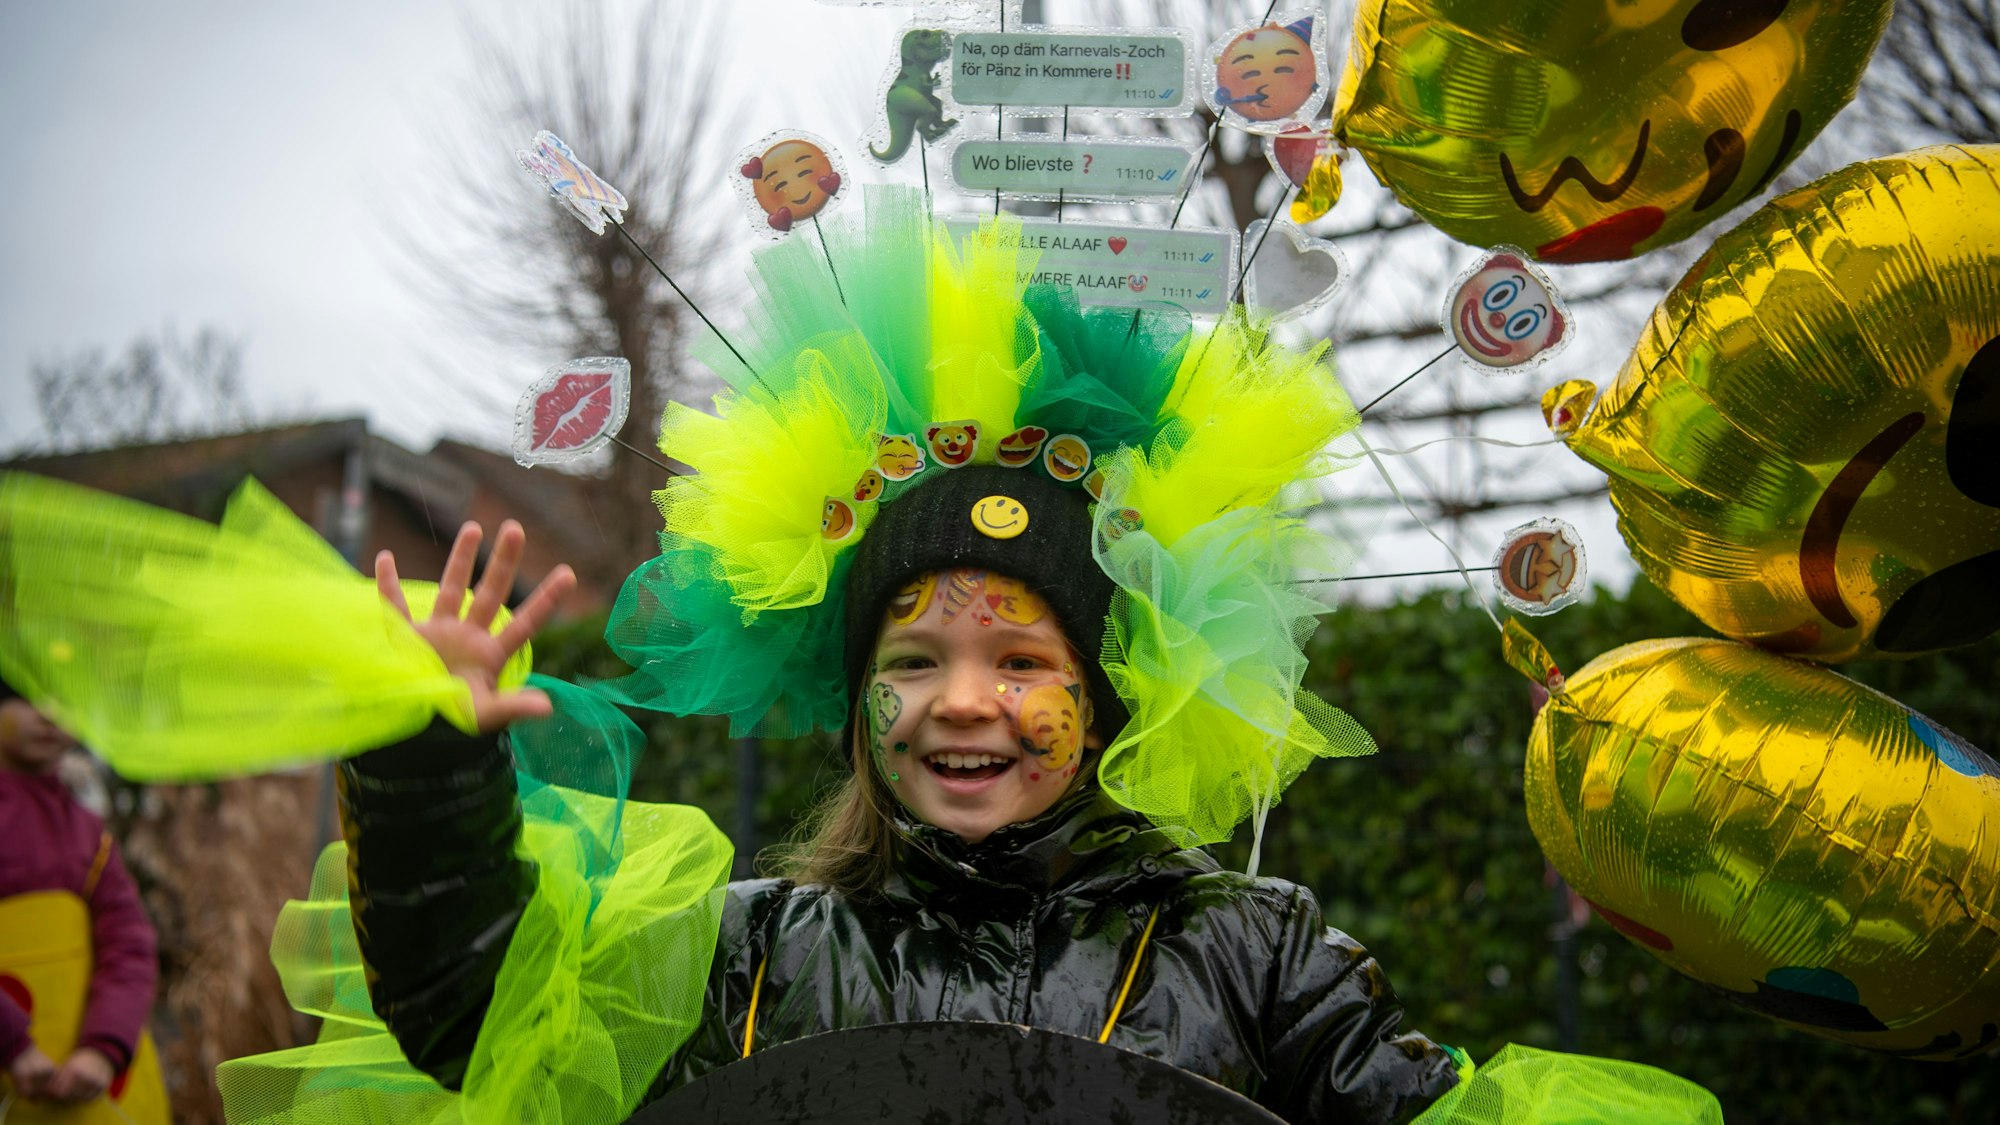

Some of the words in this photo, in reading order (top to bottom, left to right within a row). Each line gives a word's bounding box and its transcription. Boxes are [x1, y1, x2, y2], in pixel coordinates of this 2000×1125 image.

[962, 42, 986, 57] Na,
[990, 44, 1009, 60] op
[1014, 42, 1045, 57] däm
[1050, 43, 1165, 58] Karnevals-Zoch
[961, 63, 981, 76] för
[986, 63, 1021, 77] Pänz
[1025, 64, 1038, 77] in
[1124, 89, 1156, 99] 11:10
[972, 155, 999, 170] Wo
[1005, 155, 1073, 171] blievste
[1116, 167, 1154, 180] 11:10
[1051, 236, 1102, 251] ALAAF
[1163, 250, 1194, 262] 11:11
[1076, 273, 1127, 289] ALAAF
[1162, 287, 1192, 298] 11:11
